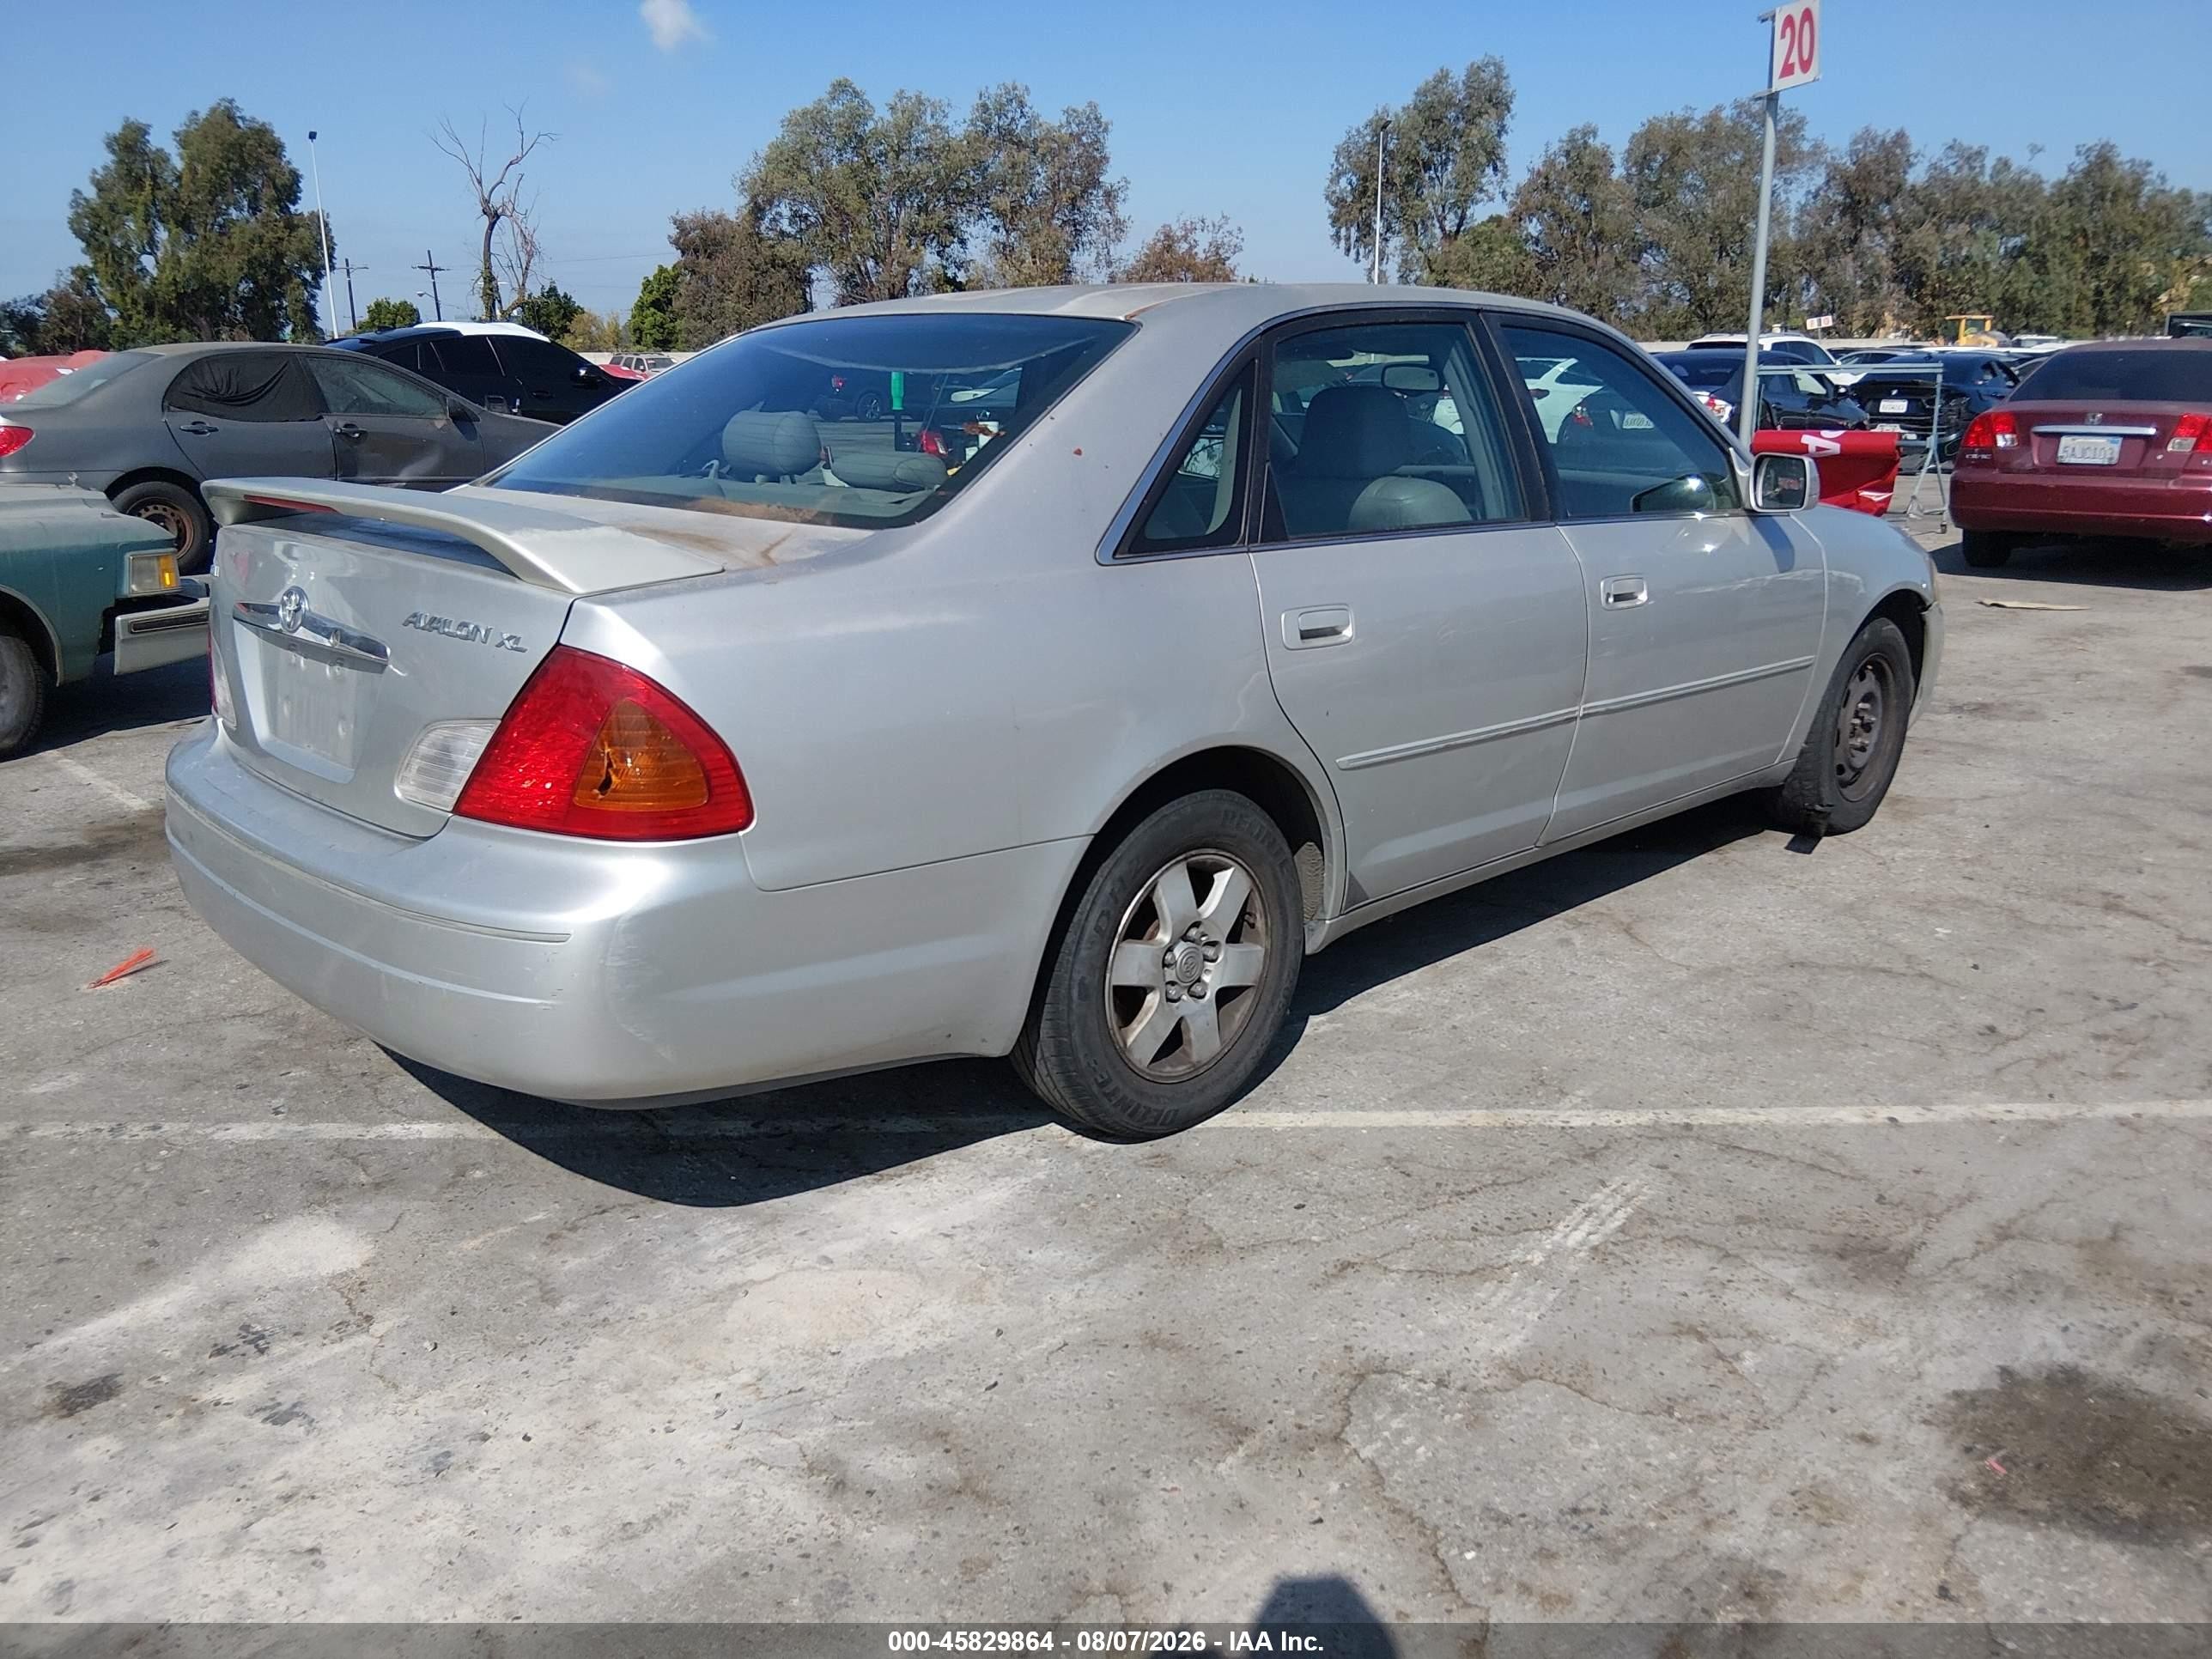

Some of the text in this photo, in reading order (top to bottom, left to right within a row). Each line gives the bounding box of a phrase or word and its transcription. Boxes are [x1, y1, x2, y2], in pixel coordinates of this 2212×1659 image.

[1778, 7, 1815, 80] 20
[401, 611, 528, 653] AVALON XL
